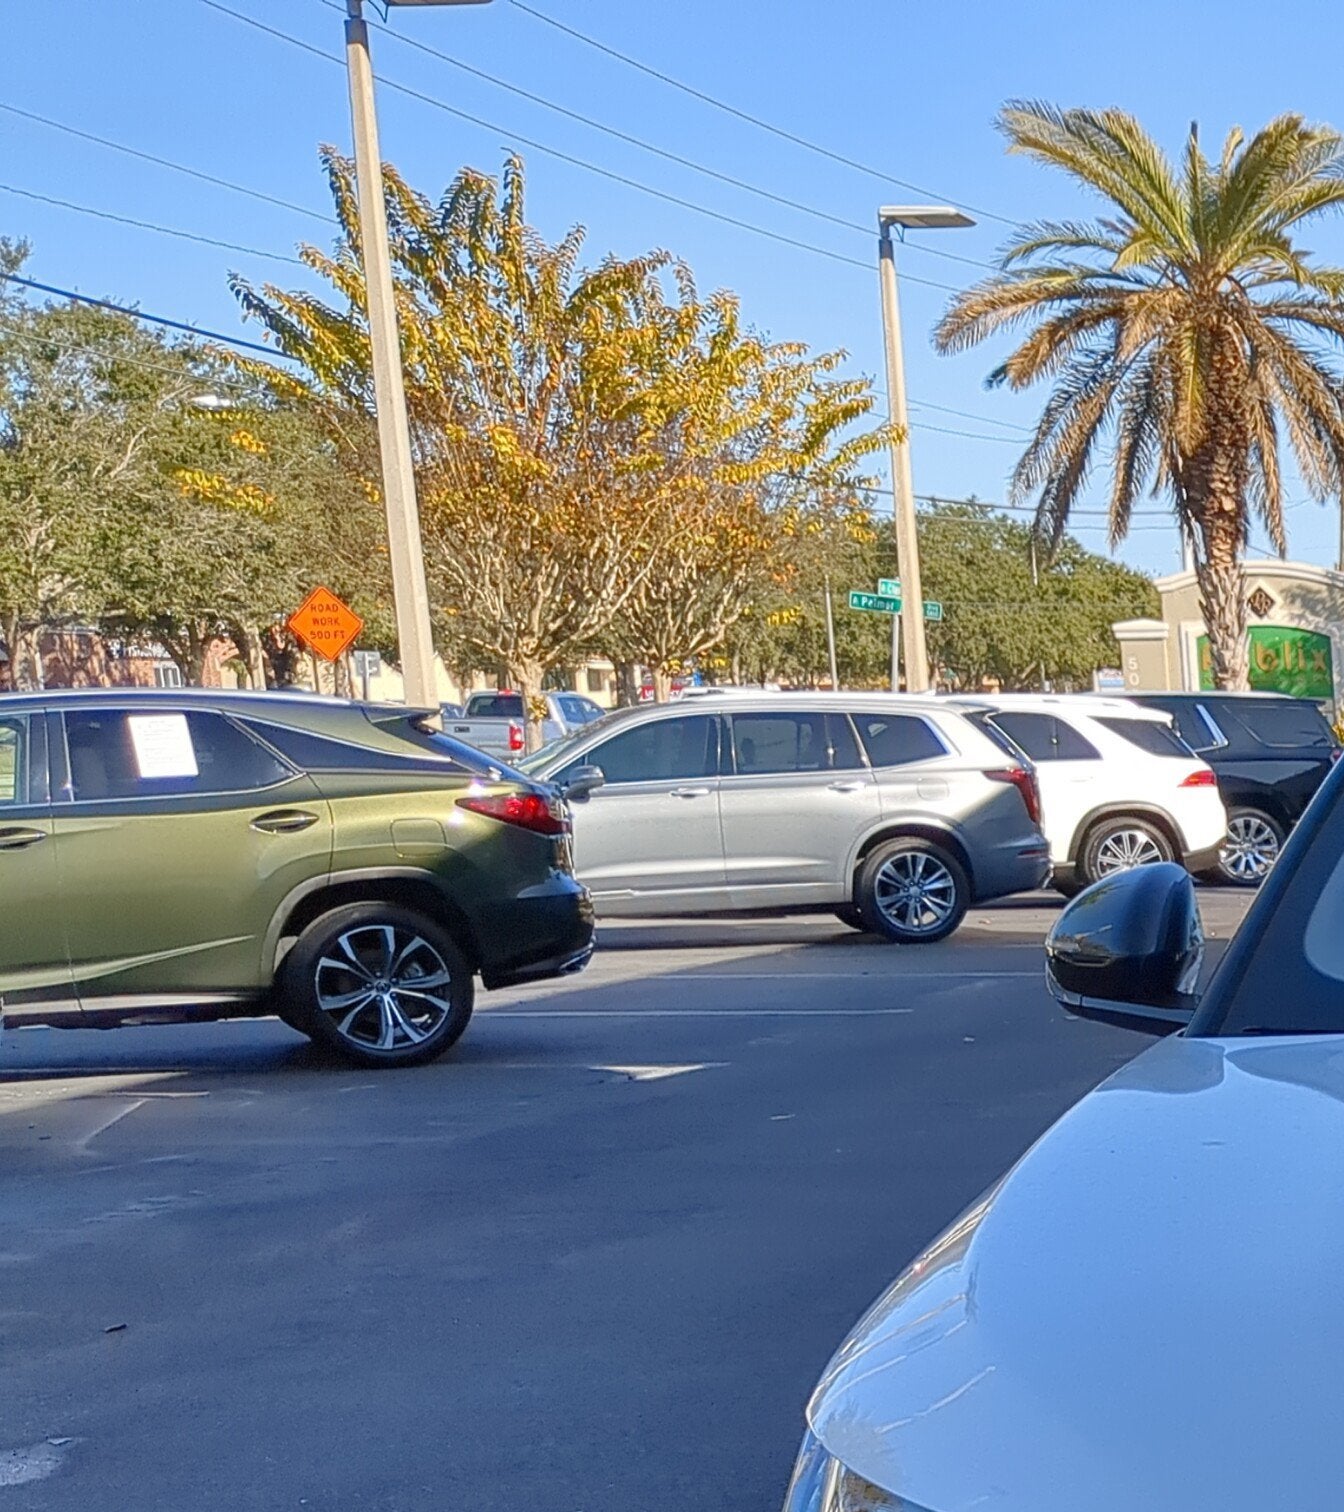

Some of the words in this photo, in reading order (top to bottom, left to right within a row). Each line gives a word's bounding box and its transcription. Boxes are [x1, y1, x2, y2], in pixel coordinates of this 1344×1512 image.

[310, 603, 339, 613] ROAD
[312, 617, 340, 626] WORK
[310, 630, 331, 640] 500
[334, 630, 345, 639] FT
